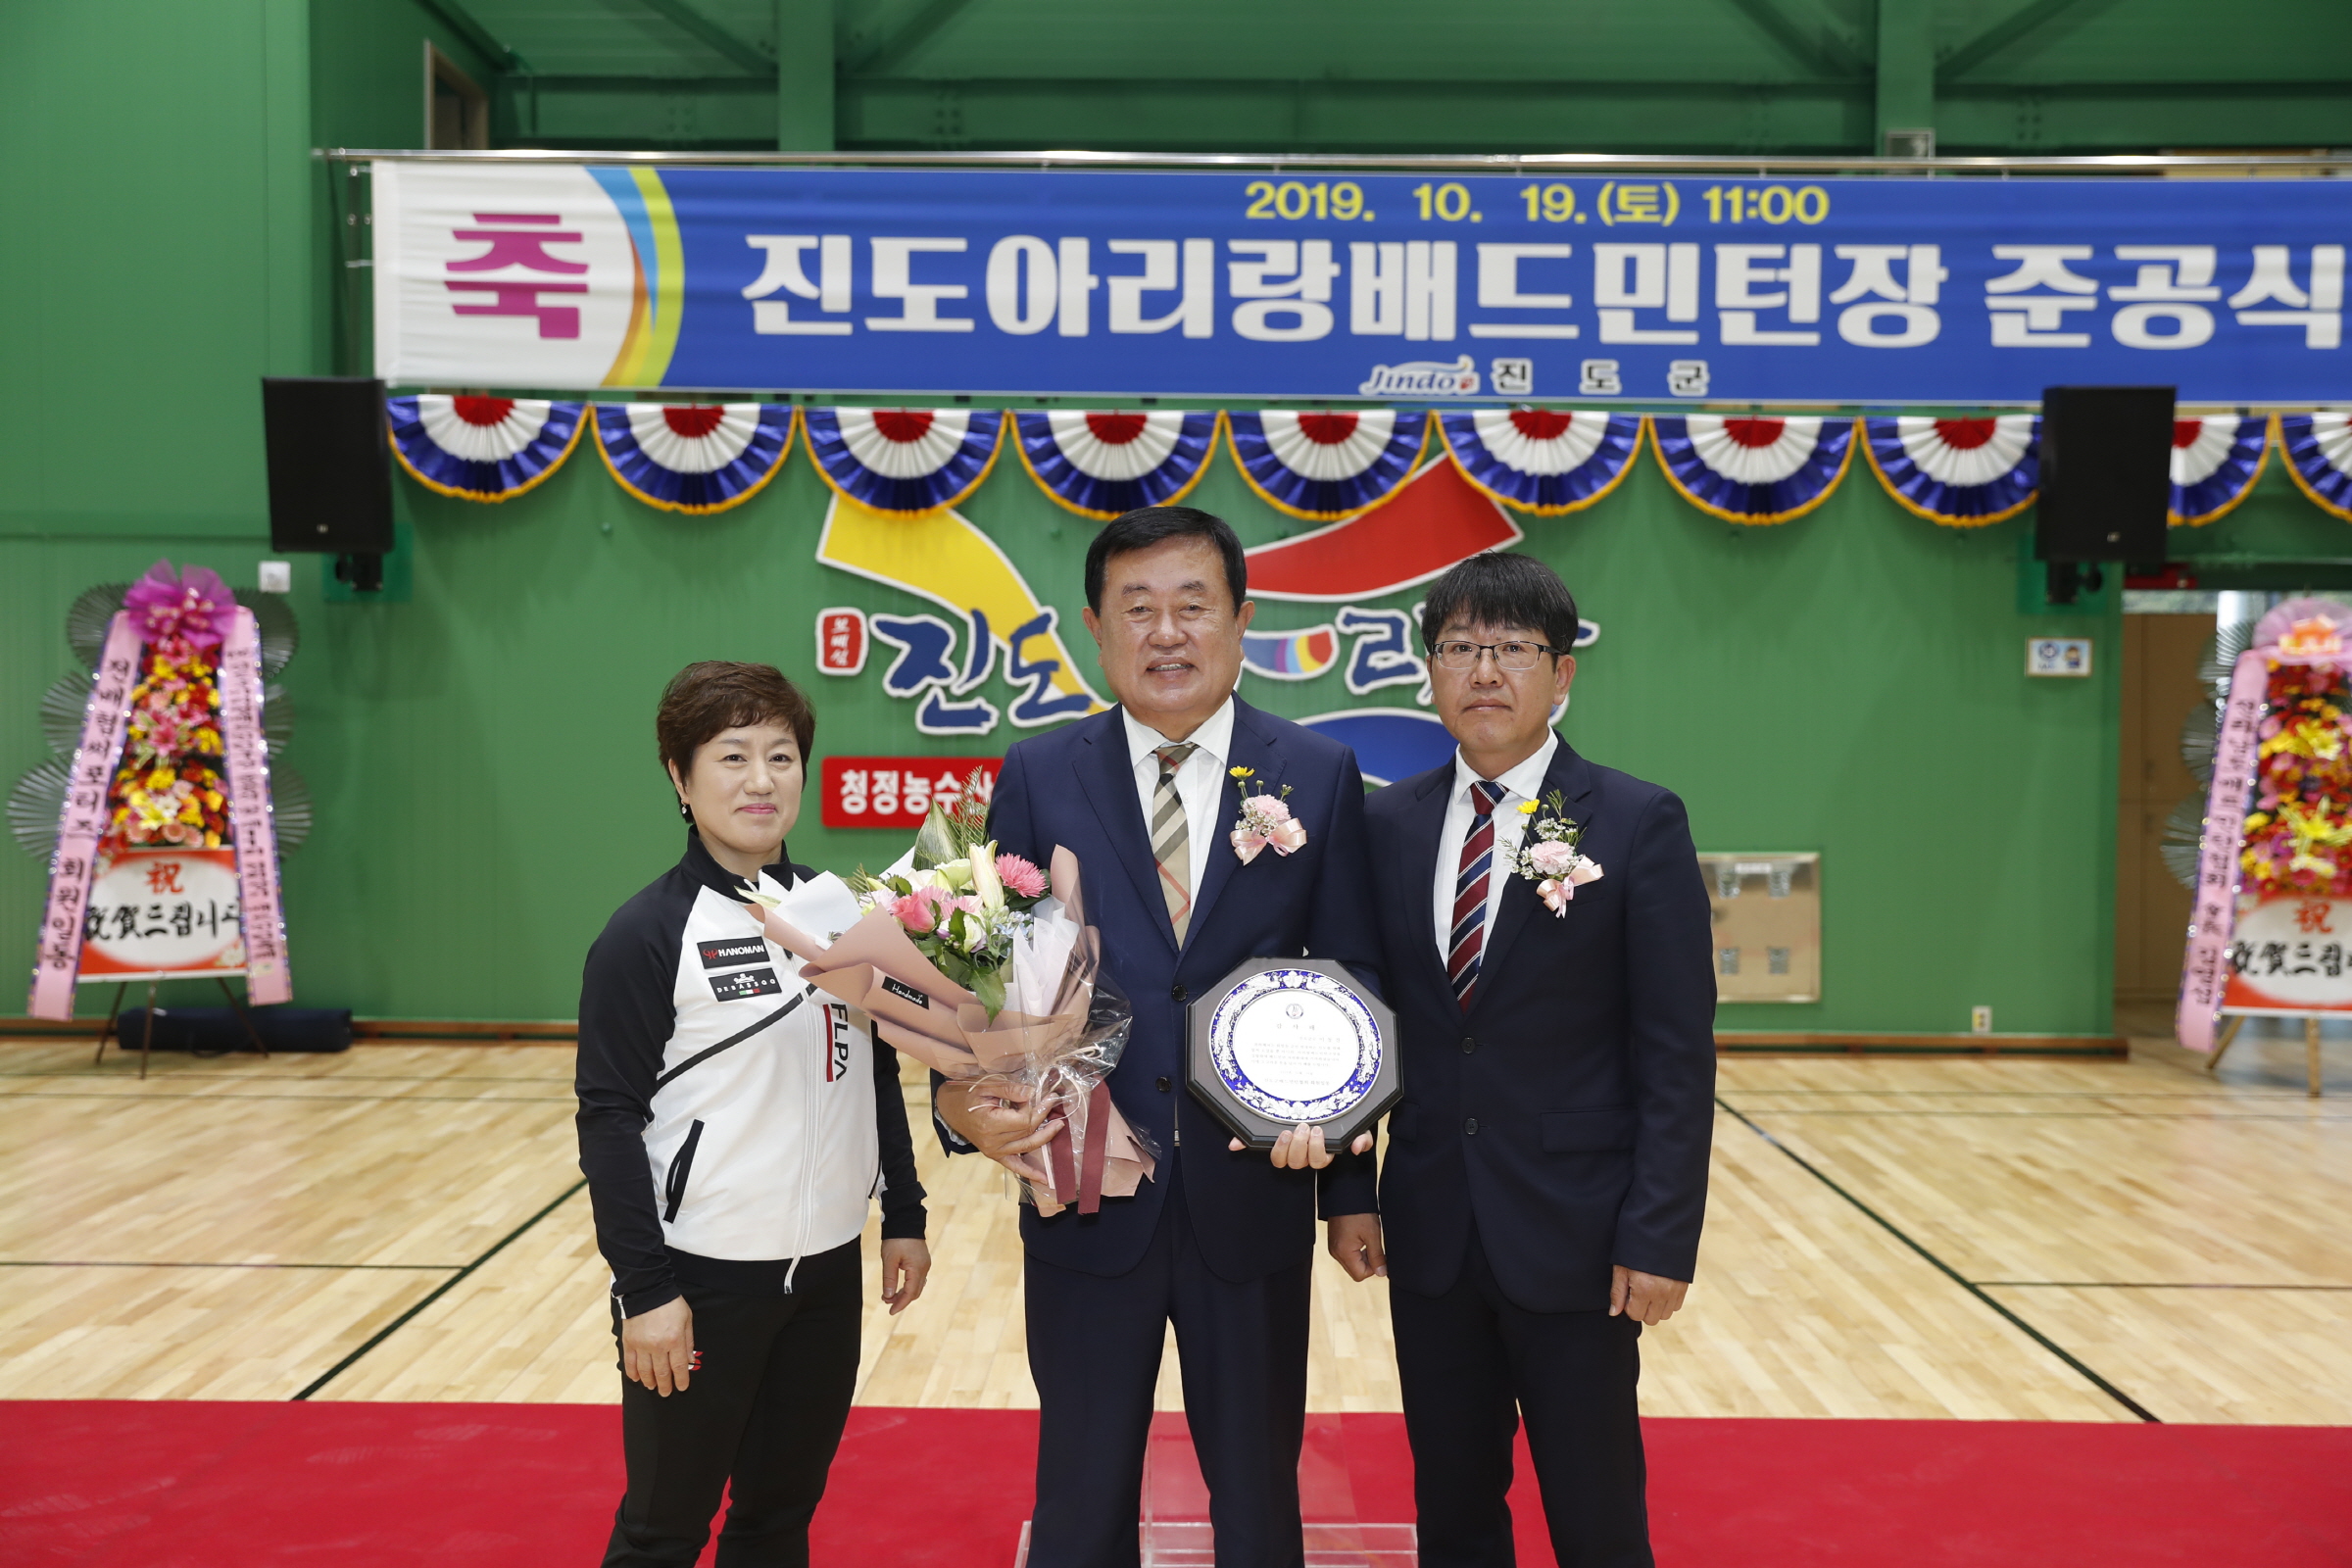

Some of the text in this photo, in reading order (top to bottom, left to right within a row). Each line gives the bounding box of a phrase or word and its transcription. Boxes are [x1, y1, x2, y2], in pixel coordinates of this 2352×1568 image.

[1245, 179, 1376, 221] 2019.
[1412, 182, 1484, 222] 10.
[1701, 184, 1831, 225] 11:00
[443, 212, 590, 340] 축
[741, 233, 2347, 350] 진도아리랑배드민턴장 준공식
[1363, 366, 1458, 394] Jindo
[870, 606, 1094, 729] 진도
[146, 861, 184, 895] 祝
[717, 944, 765, 957] HANOMAN
[891, 983, 924, 1005] Handmade
